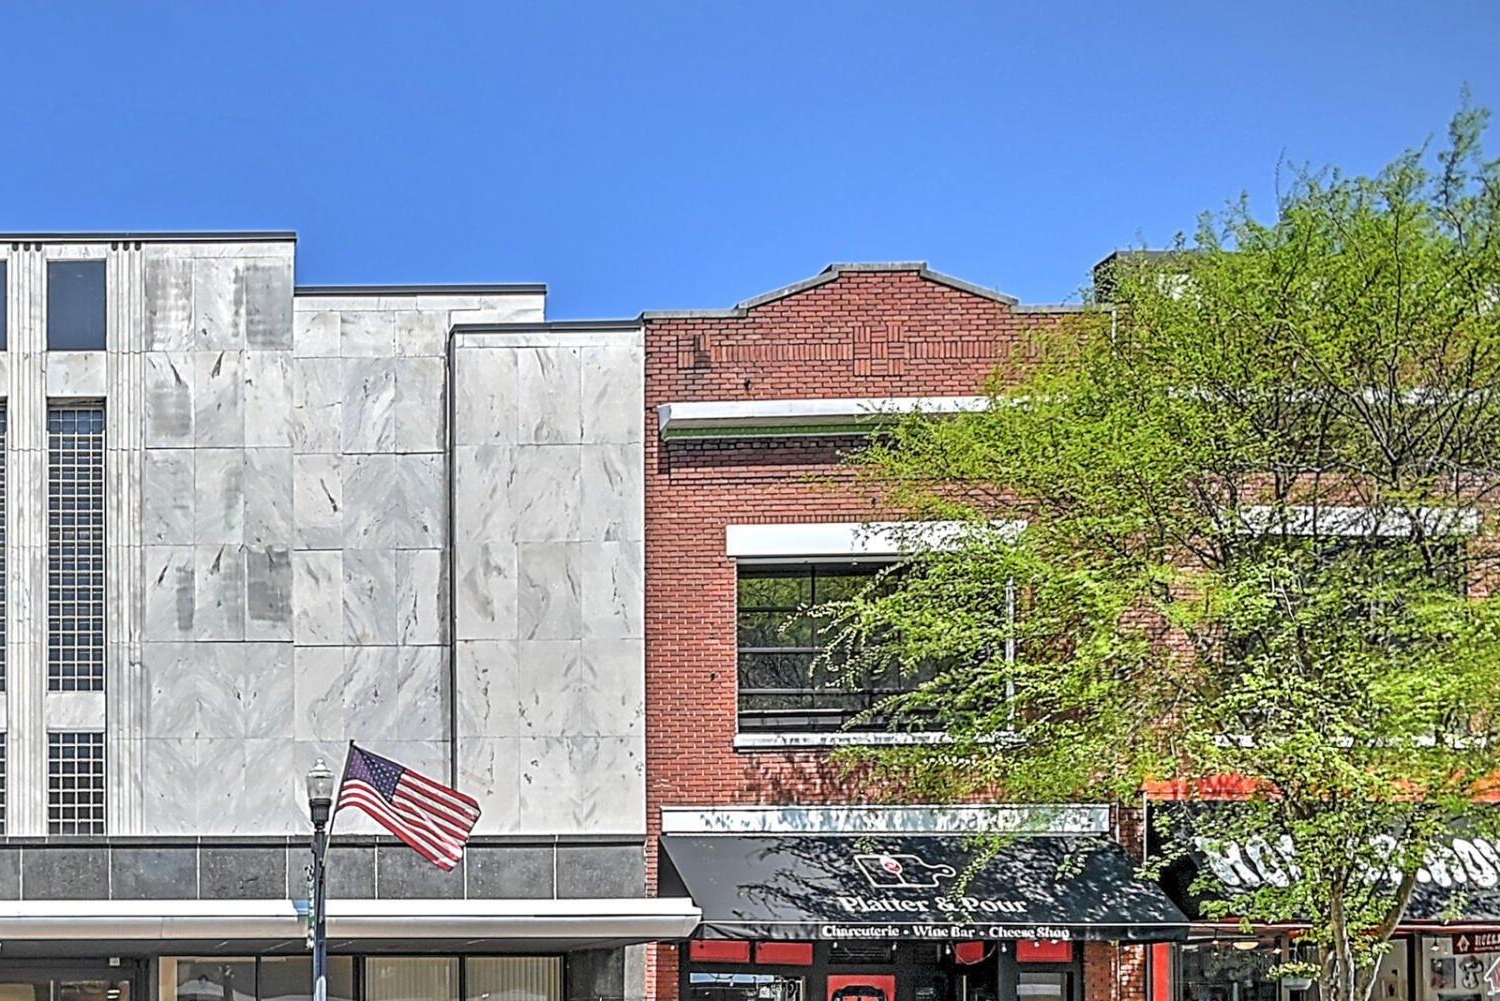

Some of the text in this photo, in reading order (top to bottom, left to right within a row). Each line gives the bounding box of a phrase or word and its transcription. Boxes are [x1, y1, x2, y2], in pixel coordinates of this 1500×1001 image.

[838, 896, 929, 913] Platter
[962, 897, 1028, 913] Pour
[822, 925, 1071, 939] Charcuterie Wine Bar Cheese Shop
